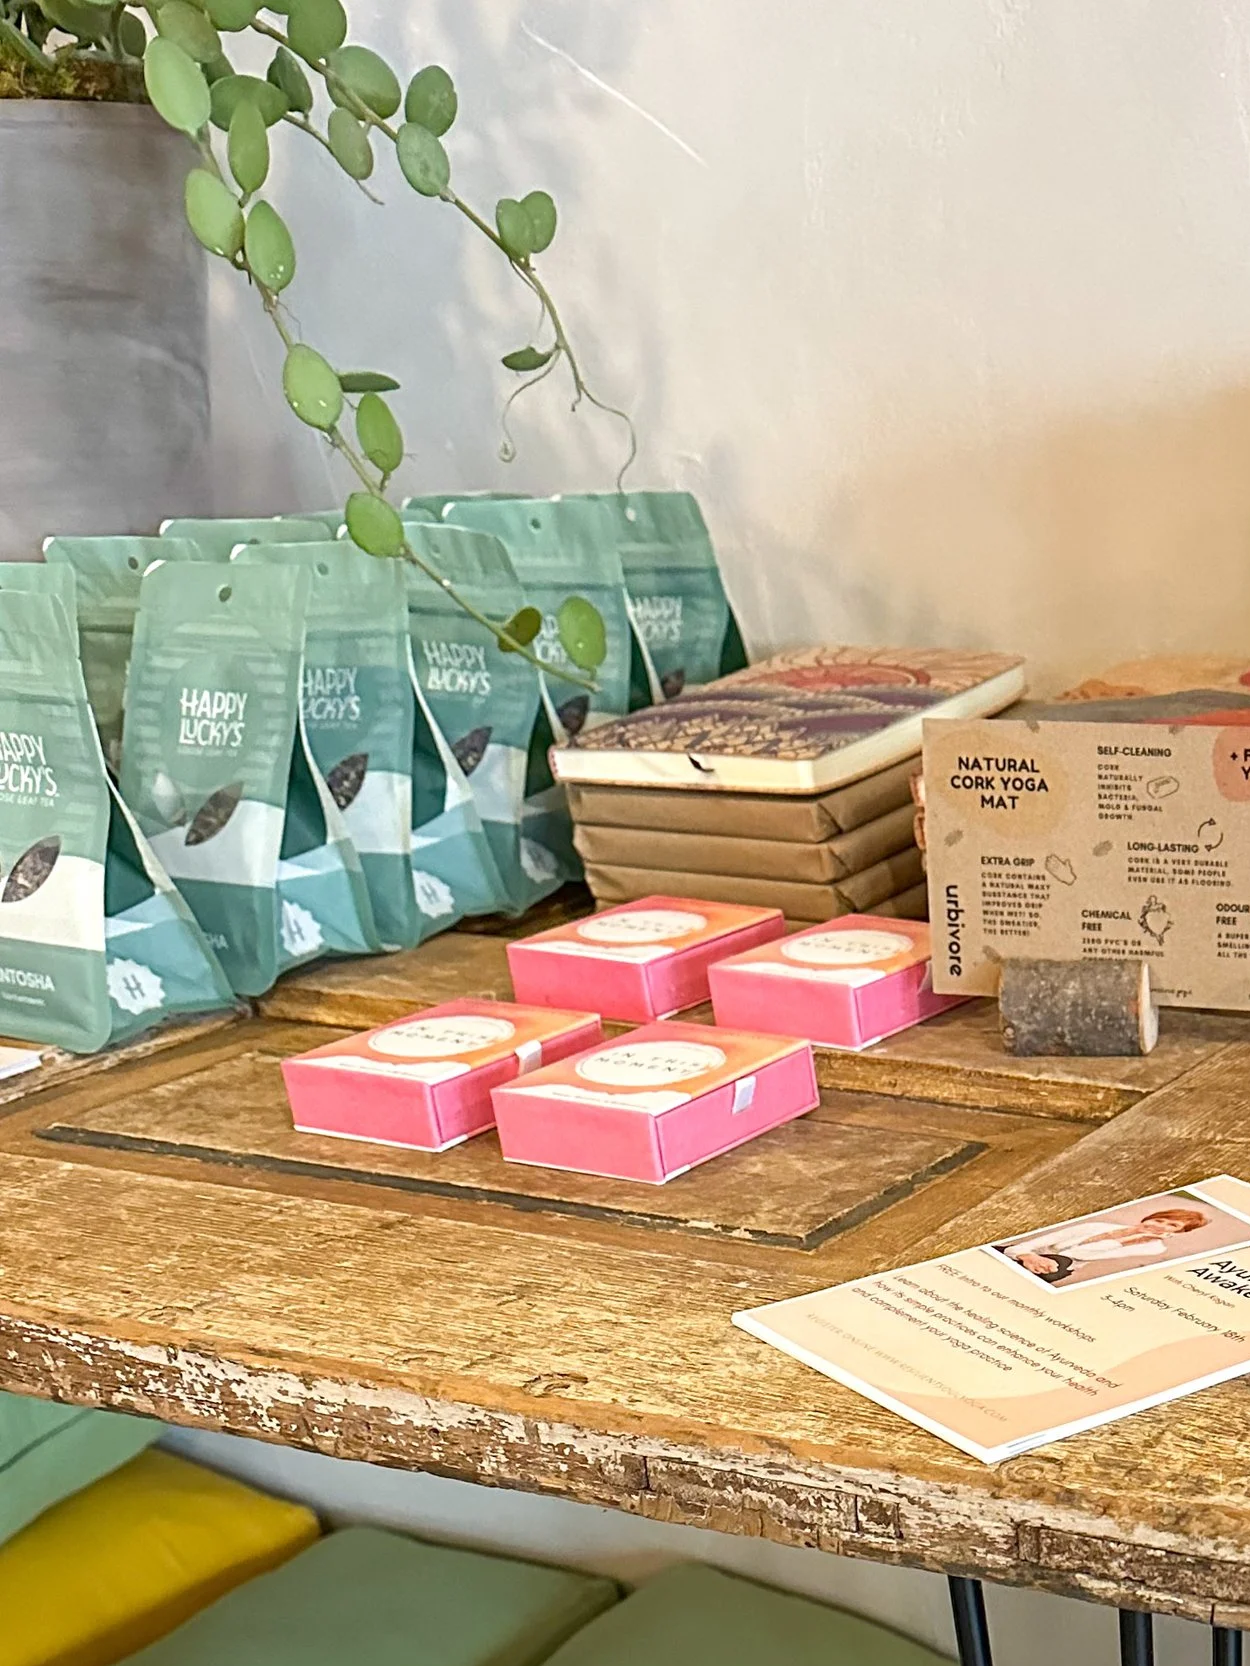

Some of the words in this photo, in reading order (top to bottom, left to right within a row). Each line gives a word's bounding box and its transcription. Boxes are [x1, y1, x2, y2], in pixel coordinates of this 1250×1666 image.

[422, 640, 486, 671] HAPPY
[303, 667, 358, 697] HAPPY
[427, 667, 491, 696] LUCKY'S
[180, 687, 249, 721] HAPPY
[302, 696, 361, 721] UCKY'S
[179, 718, 246, 748] LUCKY'S
[0, 731, 47, 766] APPY
[1097, 745, 1172, 758] SELF-CLEANING
[0, 762, 57, 797] UCKY'S
[958, 756, 1040, 774] NATURAL
[950, 774, 996, 791] CORK
[999, 776, 1049, 793] YOGA
[980, 794, 1020, 810] MAT
[980, 855, 1011, 866] EXTRA
[1012, 857, 1035, 867] GRIP
[1127, 841, 1200, 854] LONG-LASTING
[1080, 909, 1132, 921] CHEMICAL
[1215, 902, 1250, 914] ODOUR
[1215, 915, 1237, 926] FREE
[945, 884, 966, 977] urbivore
[1081, 921, 1102, 932] FREE
[0, 966, 55, 992] NTOSHA
[935, 1263, 962, 1277] FREE
[990, 1291, 1010, 1301] our
[1007, 1299, 1046, 1318] monthly
[1044, 1316, 1097, 1343] workshops
[1123, 1286, 1173, 1311] Saturday
[1171, 1307, 1220, 1332] February
[1221, 1329, 1246, 1343] 18th
[851, 1287, 876, 1298] and
[869, 1296, 929, 1327] complement
[919, 1325, 948, 1337] your
[941, 1335, 972, 1351] yoga
[967, 1348, 1013, 1372] practice
[873, 1280, 894, 1292] how
[903, 1297, 935, 1314] simple
[929, 1312, 978, 1337] practices
[976, 1335, 998, 1346] can
[996, 1345, 1041, 1368] enhance
[1034, 1366, 1064, 1379] your
[1062, 1376, 1099, 1397] health
[918, 1288, 950, 1303] about
[947, 1301, 964, 1311] the
[962, 1308, 1000, 1330] healing
[996, 1327, 1037, 1348] science
[1095, 1376, 1123, 1389] and
